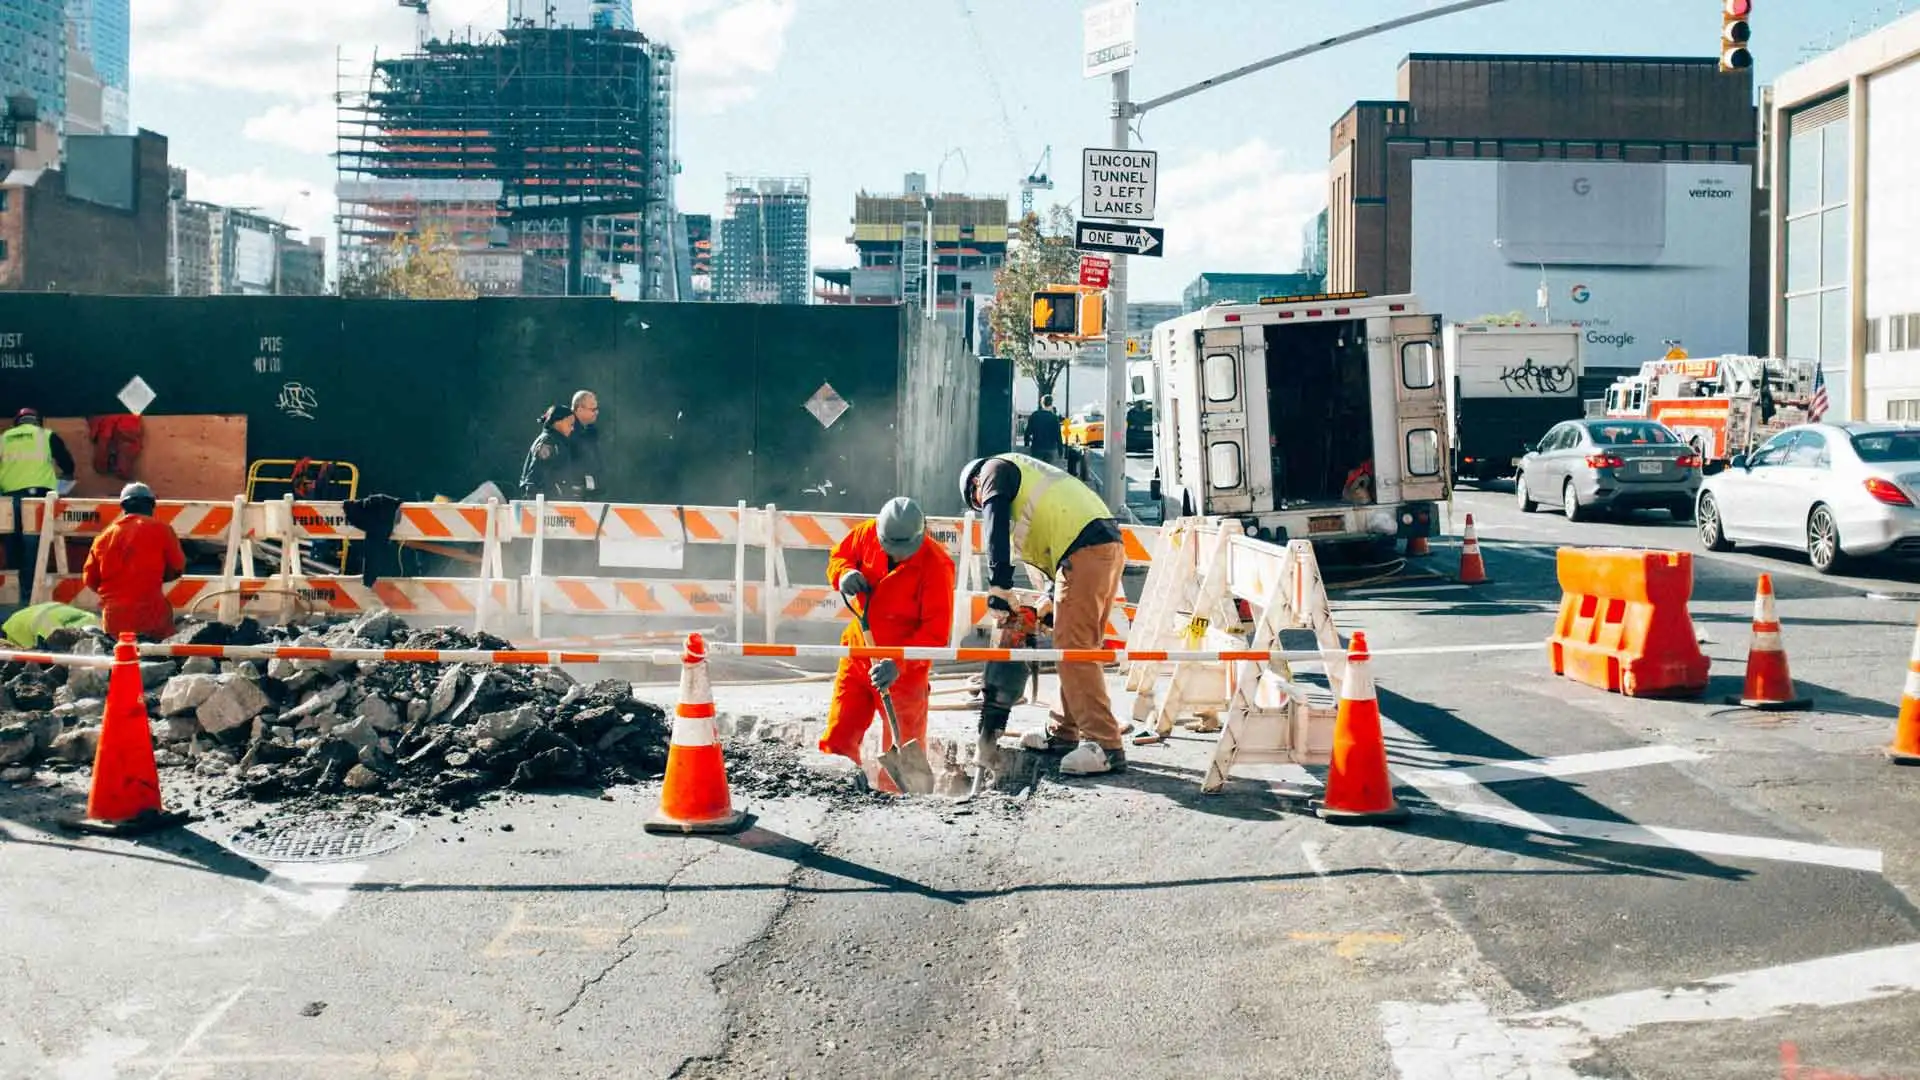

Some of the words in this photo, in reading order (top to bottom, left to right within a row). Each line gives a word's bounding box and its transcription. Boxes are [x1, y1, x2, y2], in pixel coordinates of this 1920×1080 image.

[1090, 155, 1150, 168] LINCOLN
[1092, 170, 1148, 183] TUNNEL
[1093, 185, 1102, 197] 3
[1110, 186, 1145, 198] LEFT
[1573, 178, 1591, 196] G
[1689, 187, 1731, 198] verizon
[1095, 201, 1143, 214] LANES
[1088, 231, 1113, 243] ONE
[1125, 234, 1151, 246] WAY
[1572, 285, 1590, 304] G
[0, 333, 23, 348] OST
[1586, 330, 1634, 347] Google
[63, 511, 100, 522] TRIUMPH
[544, 515, 576, 528] IUMPH
[297, 588, 336, 601] TRIUMPH
